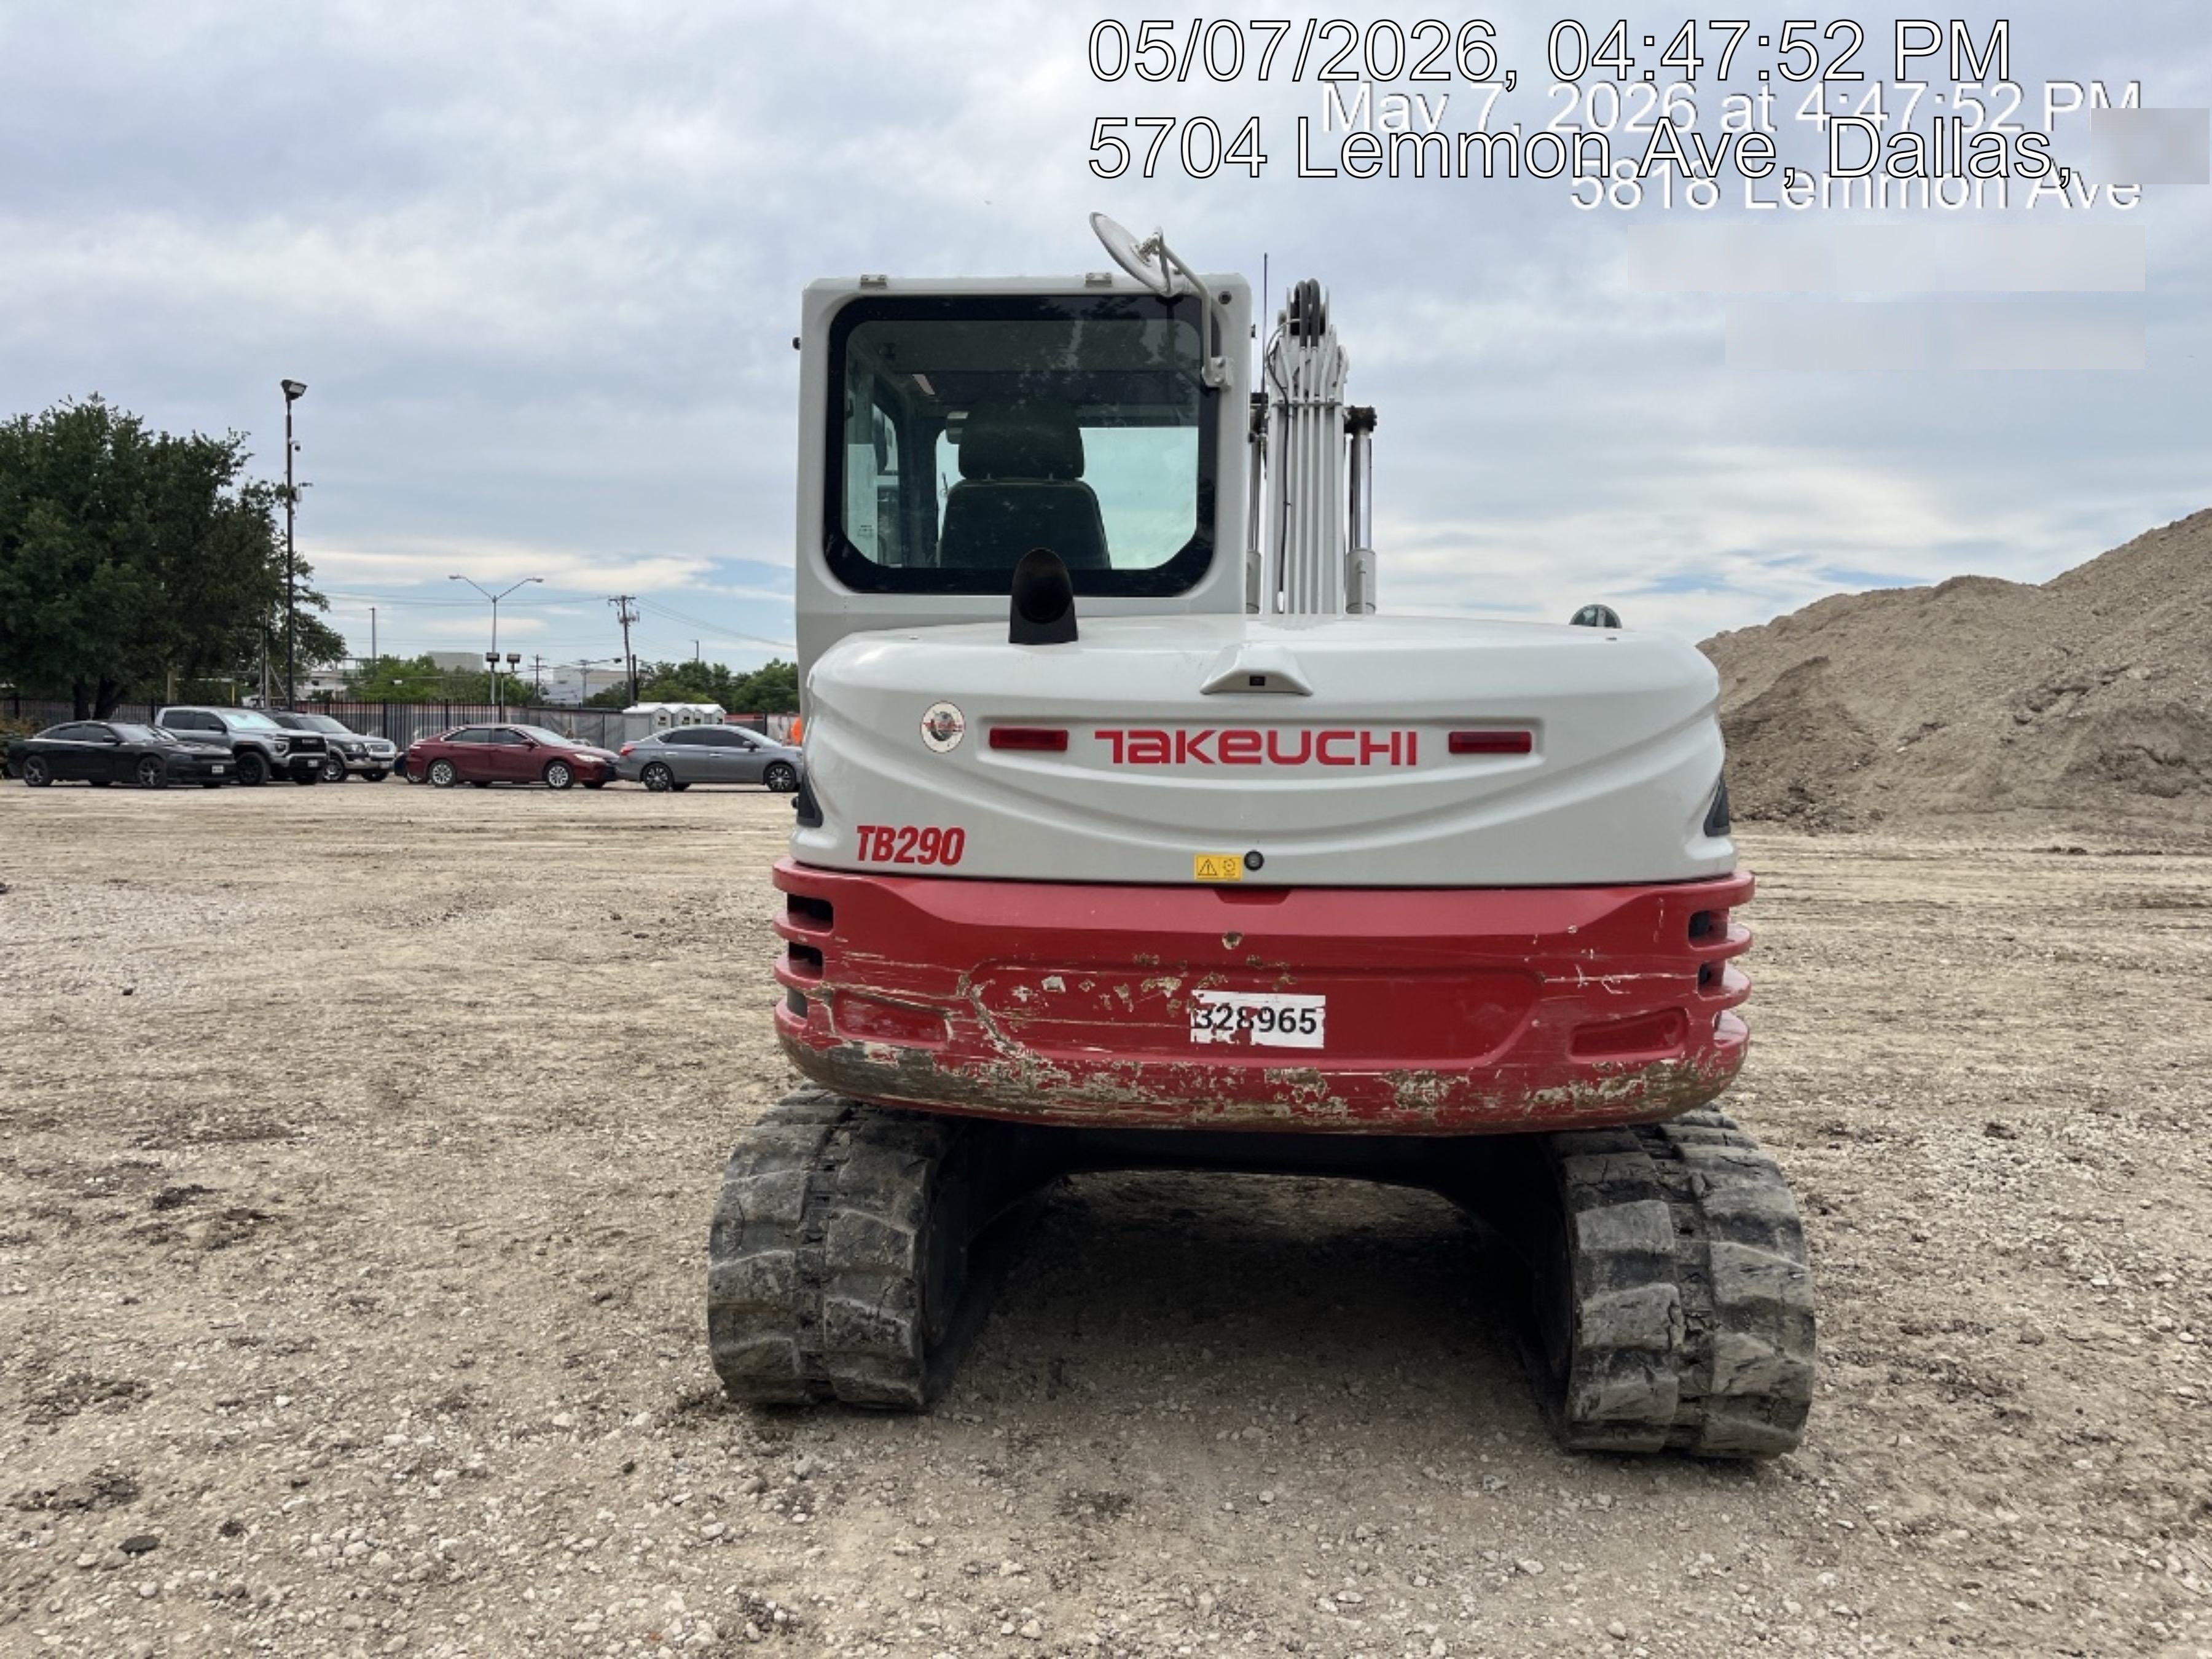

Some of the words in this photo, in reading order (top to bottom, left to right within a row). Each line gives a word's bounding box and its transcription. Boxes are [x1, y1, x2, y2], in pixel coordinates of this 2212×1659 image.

[1094, 729, 1417, 766] TAKEUCHI
[857, 825, 965, 866] TB290
[1194, 1005, 1317, 1035] 328965
